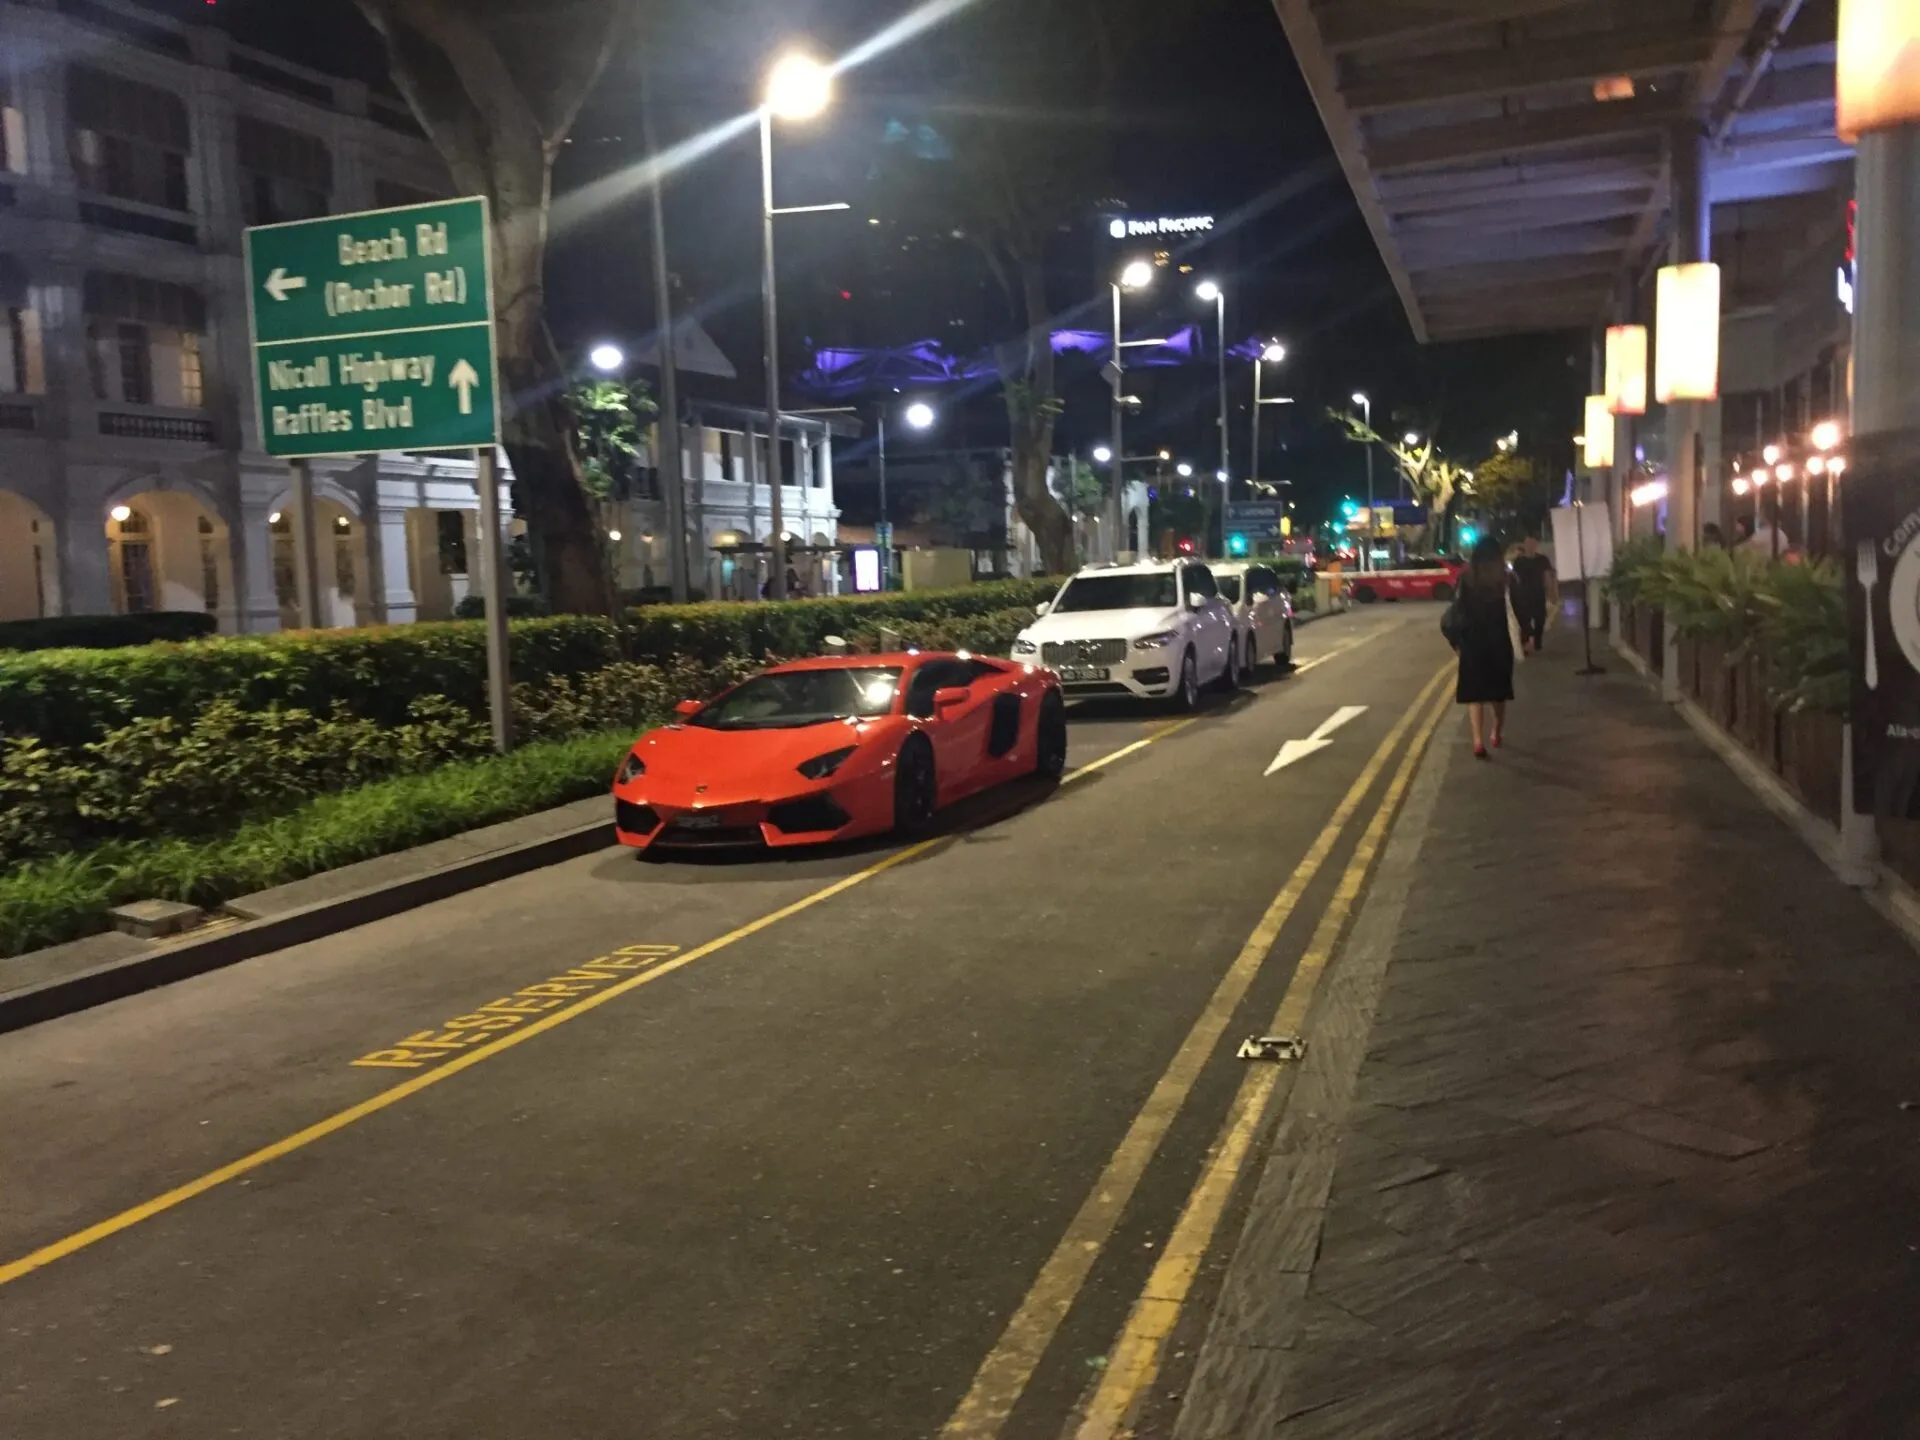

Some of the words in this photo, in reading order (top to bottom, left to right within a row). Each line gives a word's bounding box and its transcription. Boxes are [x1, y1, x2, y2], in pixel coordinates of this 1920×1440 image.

[338, 227, 408, 265] Beach
[415, 221, 448, 256] Rd
[324, 278, 414, 316] (Rochor
[424, 266, 467, 304] Rd)
[268, 355, 331, 391] Nicoll
[338, 351, 436, 392] Highway
[272, 402, 353, 436] Raffles
[362, 396, 414, 430] Blvd
[350, 944, 681, 1068] RESERVED
